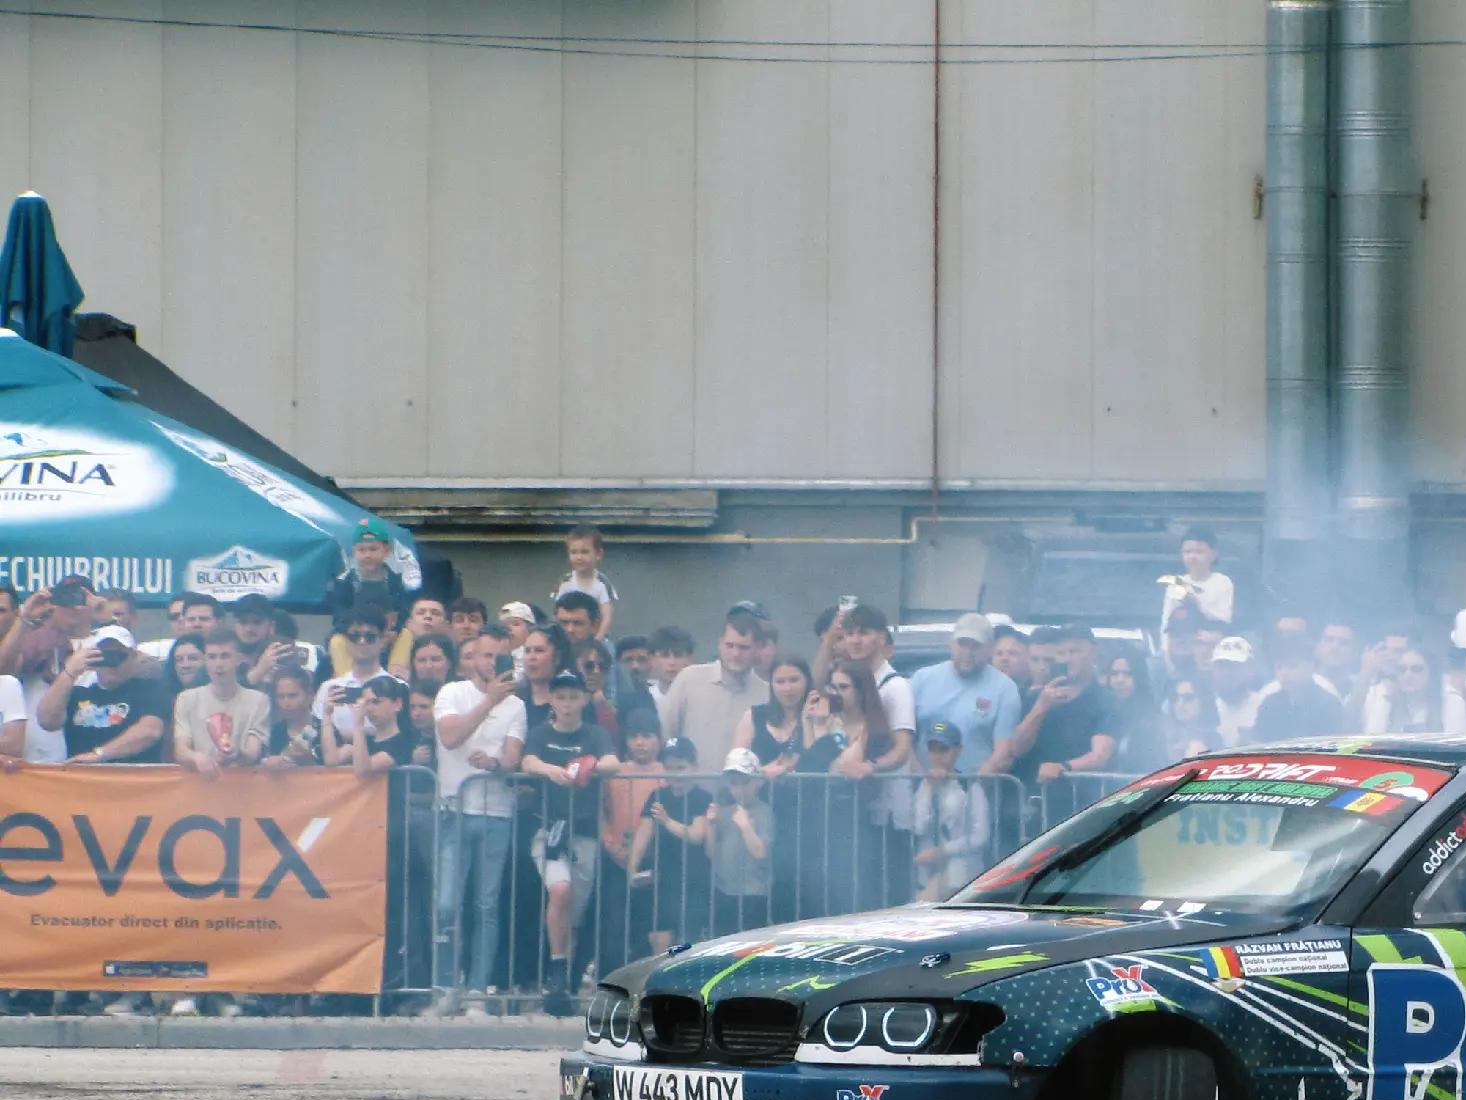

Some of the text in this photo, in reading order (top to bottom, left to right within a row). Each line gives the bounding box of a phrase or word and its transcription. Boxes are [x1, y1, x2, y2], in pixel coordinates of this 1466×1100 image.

[0, 491, 62, 501] ilibru
[196, 570, 280, 585] BUCOVINA
[0, 812, 332, 900] evax
[30, 913, 114, 928] Evacuator
[120, 913, 169, 929] direct
[174, 914, 200, 929] din
[1086, 964, 1157, 1000] ProX
